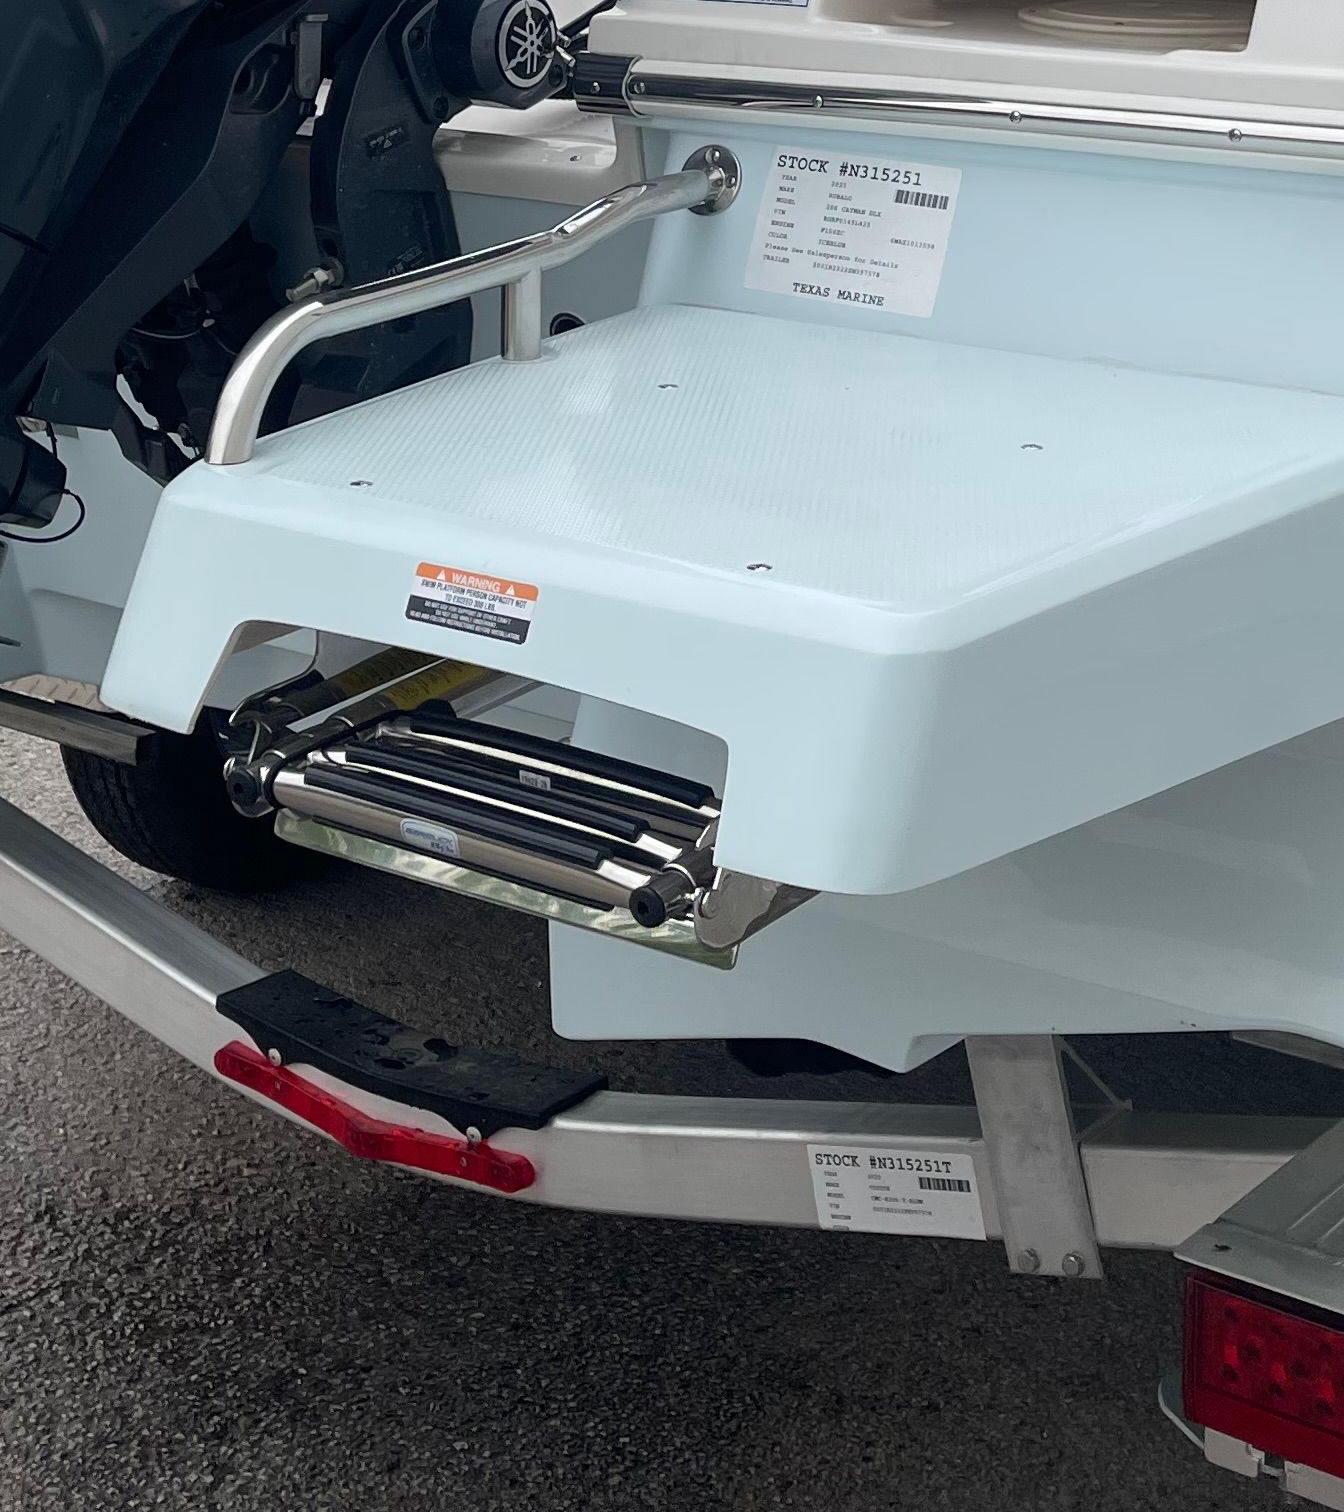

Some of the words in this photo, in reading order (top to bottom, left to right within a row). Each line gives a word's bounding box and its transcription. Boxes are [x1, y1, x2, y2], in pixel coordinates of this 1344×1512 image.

[777, 155, 829, 173] STOCK
[840, 162, 922, 186] #N315251
[793, 283, 830, 297] TEXAS
[837, 290, 885, 306] MARINE
[452, 572, 500, 592] WARNING
[816, 1153, 860, 1167] STOCK
[869, 1155, 951, 1173] #N315251T
